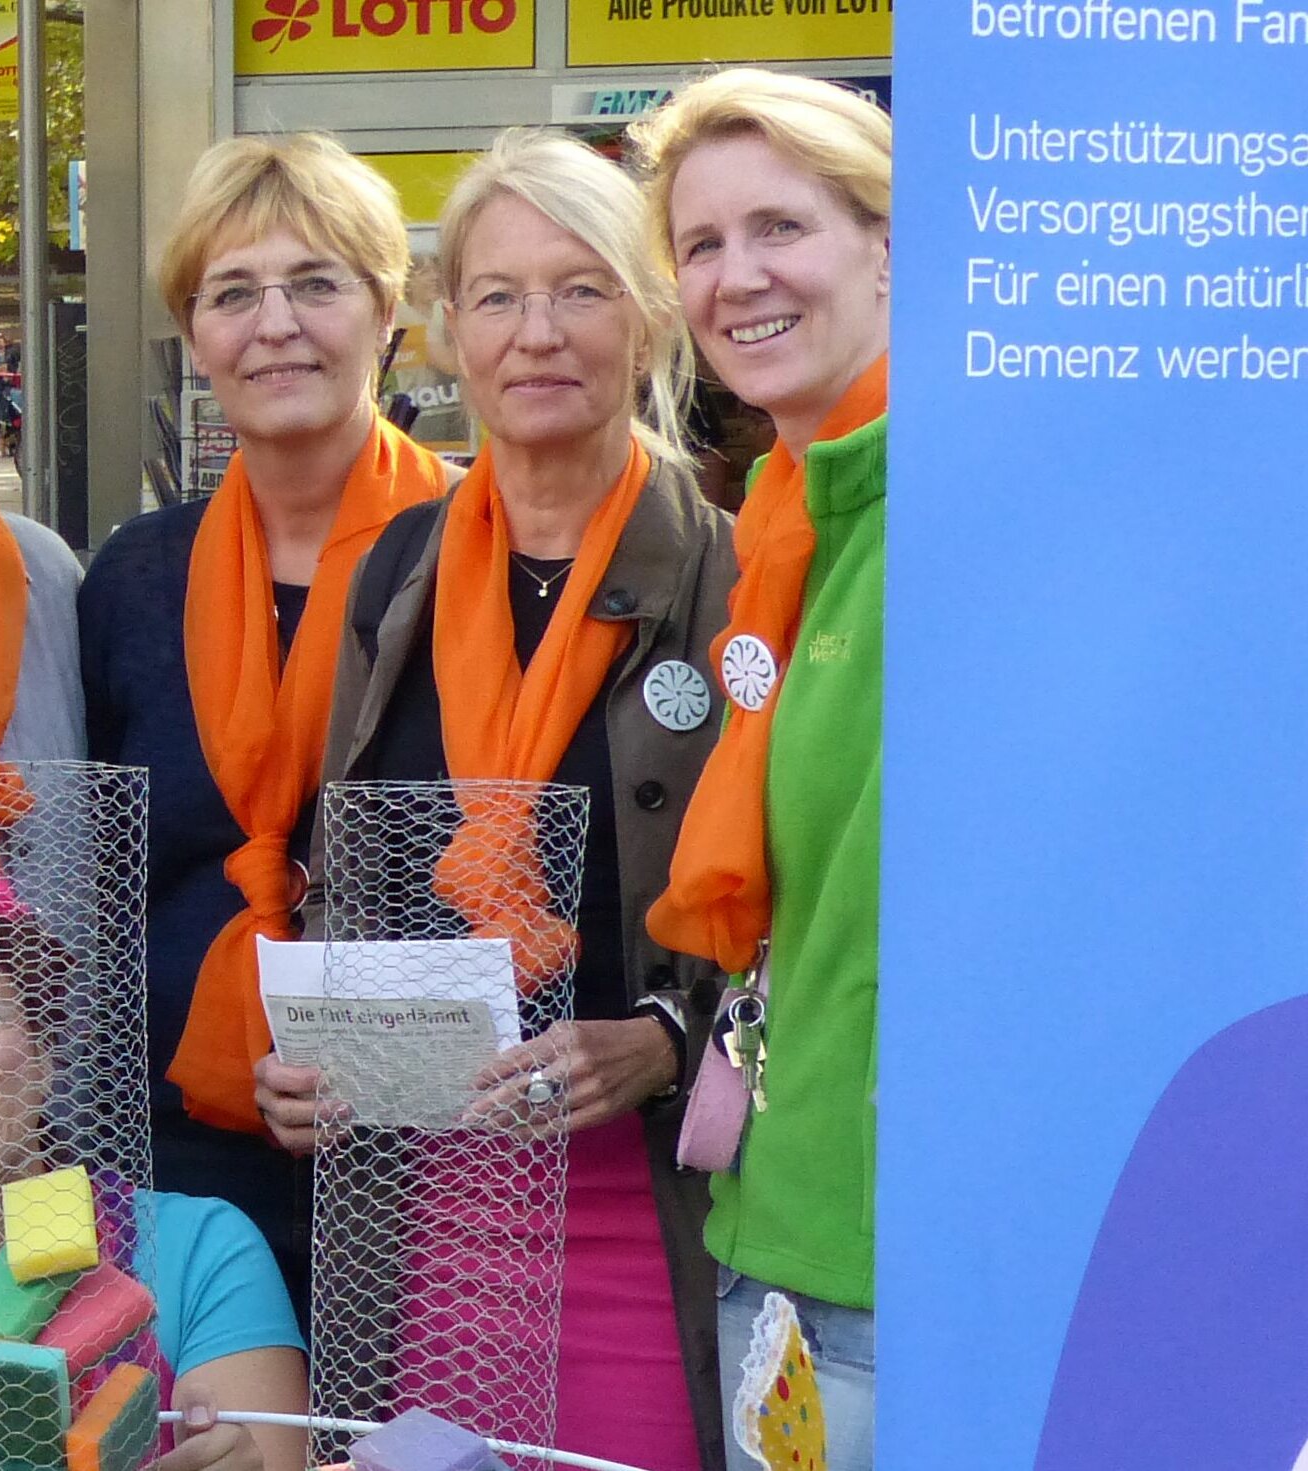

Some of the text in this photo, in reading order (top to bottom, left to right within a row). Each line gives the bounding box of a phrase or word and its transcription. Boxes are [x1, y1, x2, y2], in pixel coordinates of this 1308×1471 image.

[332, 0, 517, 37] LOTTO
[608, 0, 652, 21] Alle
[661, 0, 774, 19] Produkte
[785, 0, 826, 15] von
[971, 0, 1216, 43] betroffenen
[969, 113, 1308, 177] Unterstützungsa
[967, 258, 1039, 305] Für
[1056, 260, 1166, 307] einen
[965, 330, 1139, 379] Demenz
[287, 1006, 316, 1023] Die
